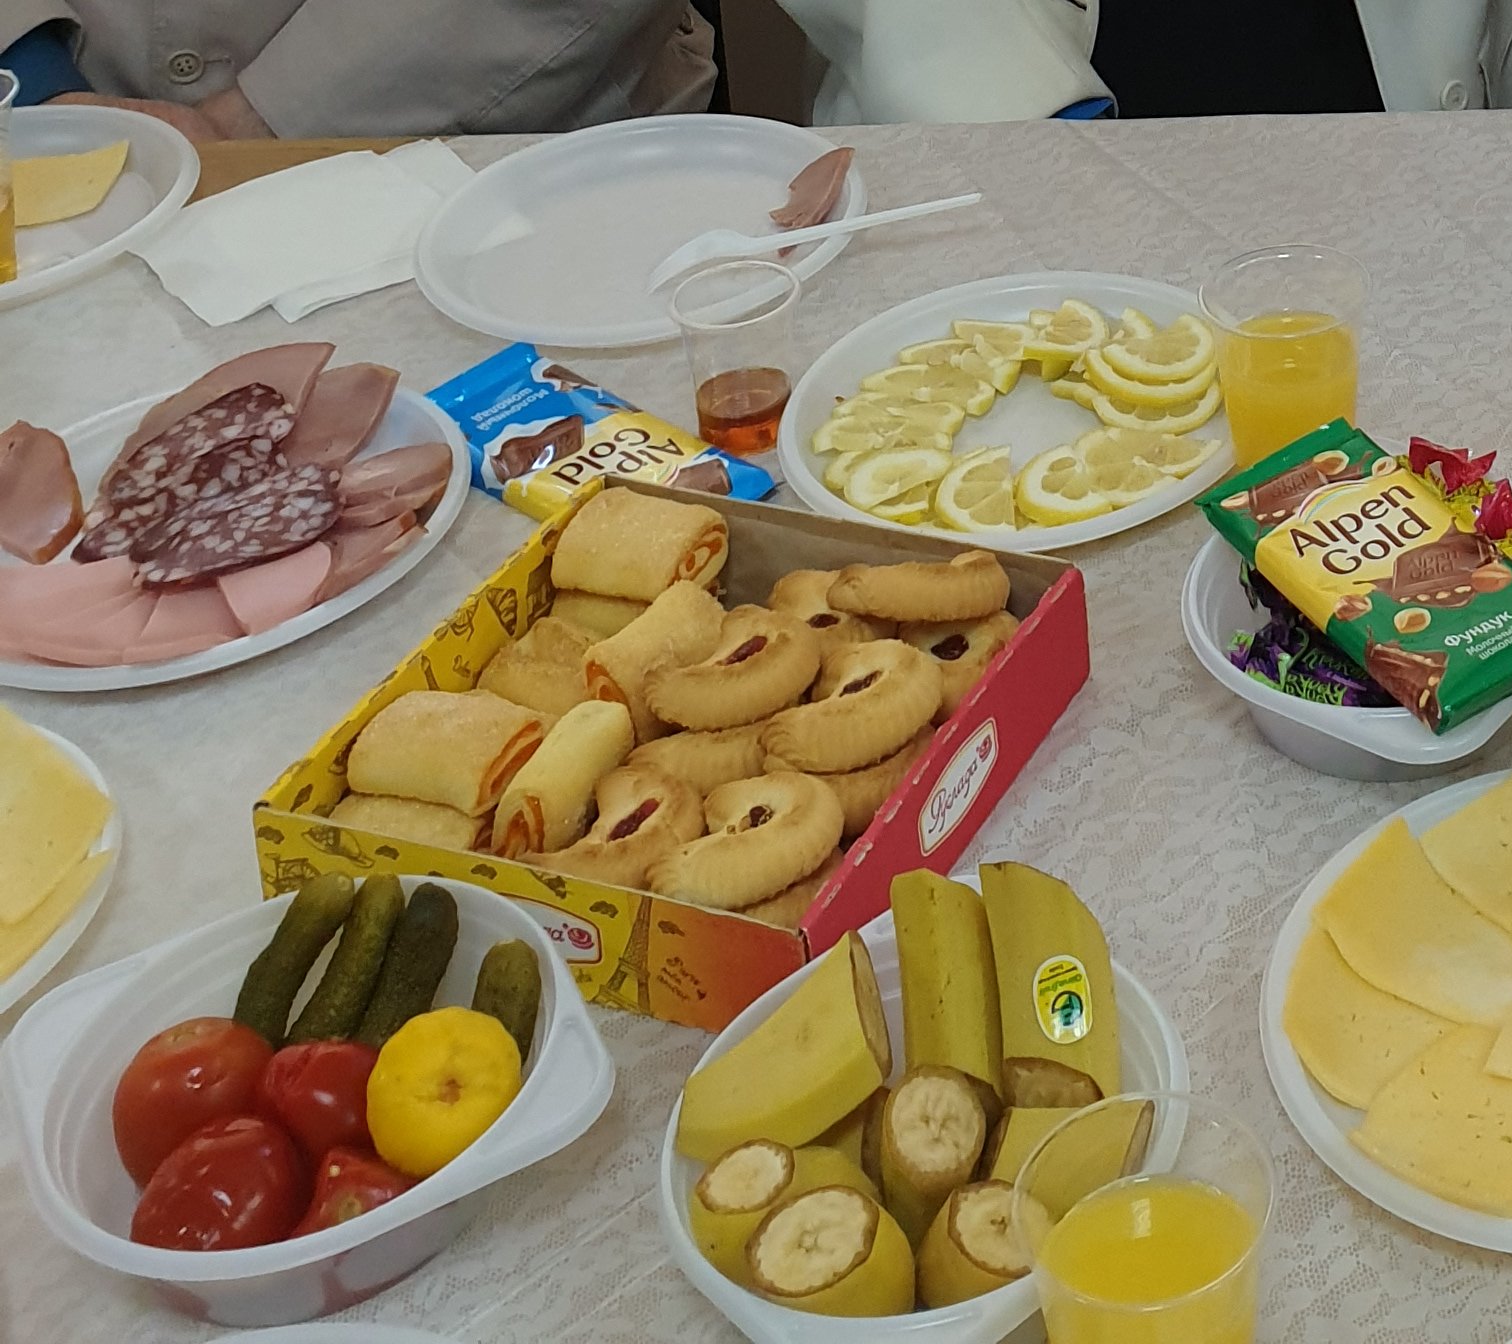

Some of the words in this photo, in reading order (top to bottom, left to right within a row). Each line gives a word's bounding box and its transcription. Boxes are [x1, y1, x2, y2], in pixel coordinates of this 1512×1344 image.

[471, 387, 533, 422] шоколад
[476, 389, 549, 432] Молочный
[551, 427, 651, 485] Gold
[617, 437, 685, 474] Alp
[1289, 485, 1416, 558] Alpen
[1321, 507, 1432, 575] Gold
[1409, 550, 1459, 569] Alpen
[1409, 558, 1454, 579] Gold
